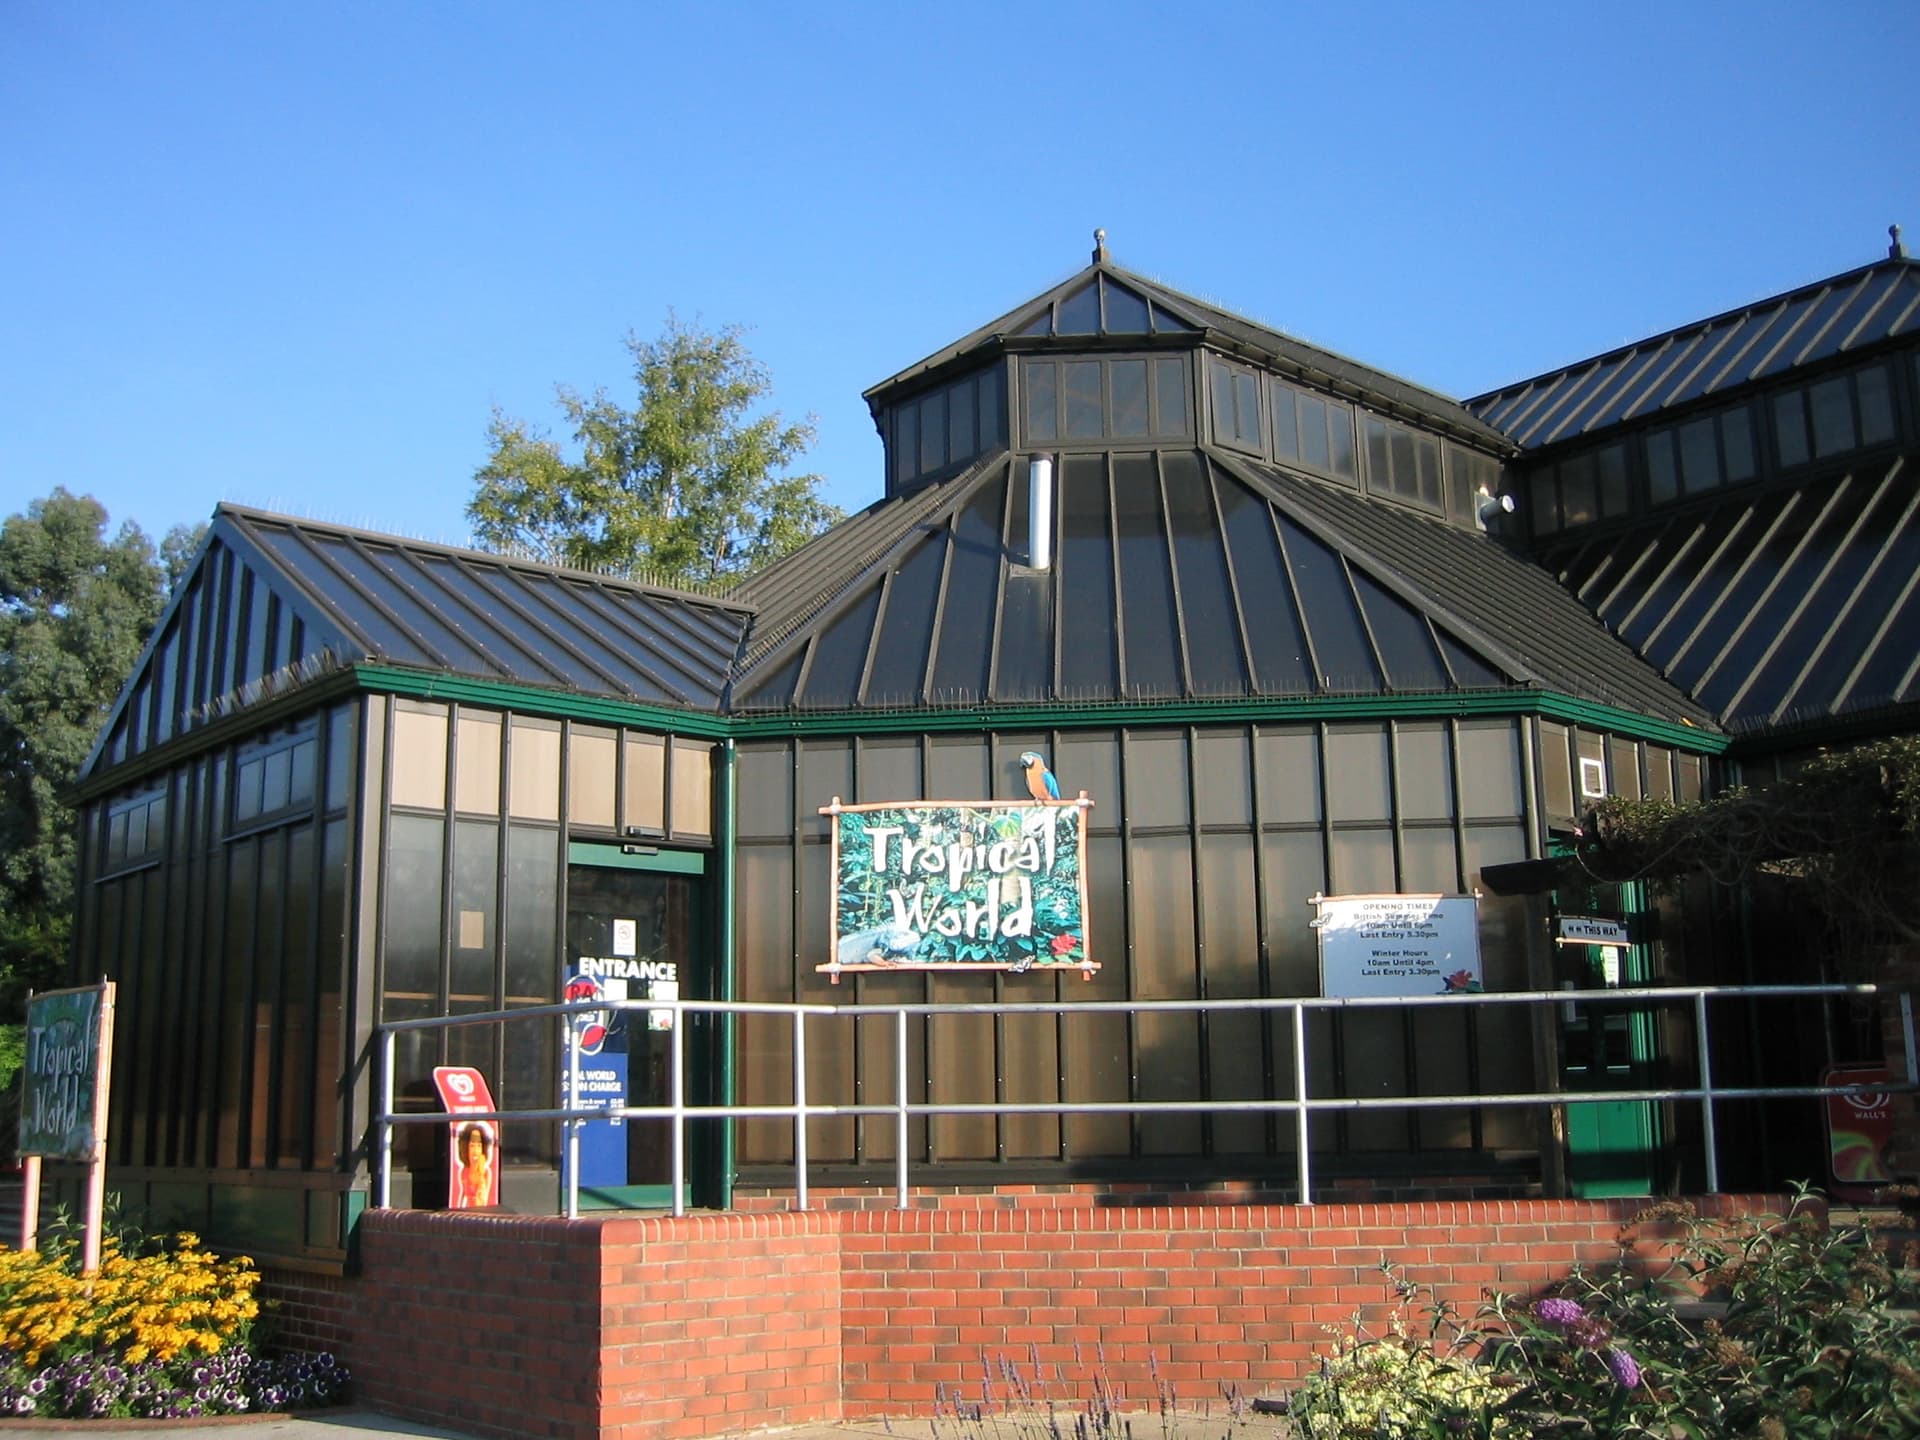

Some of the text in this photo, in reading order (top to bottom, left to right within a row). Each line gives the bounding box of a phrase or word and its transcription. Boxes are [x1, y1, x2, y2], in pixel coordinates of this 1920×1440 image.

[862, 807, 1058, 892] Tropical
[887, 876, 1035, 941] World
[1363, 903, 1403, 911] OPENING
[1354, 912, 1383, 920] British
[1422, 912, 1444, 920] Time
[1366, 921, 1389, 929] 10am
[1391, 921, 1412, 929] Until
[1584, 925, 1617, 936] THIS WAY
[1360, 931, 1438, 940] Last Entry 5.30pm
[579, 956, 677, 981] ENTRANCE
[1383, 969, 1406, 977] Entry
[32, 993, 95, 1093] Tropical
[586, 1070, 616, 1081] WORLD
[588, 1081, 622, 1092] CHARGE
[34, 1074, 79, 1135] World
[1855, 1111, 1886, 1119] WALL'S
